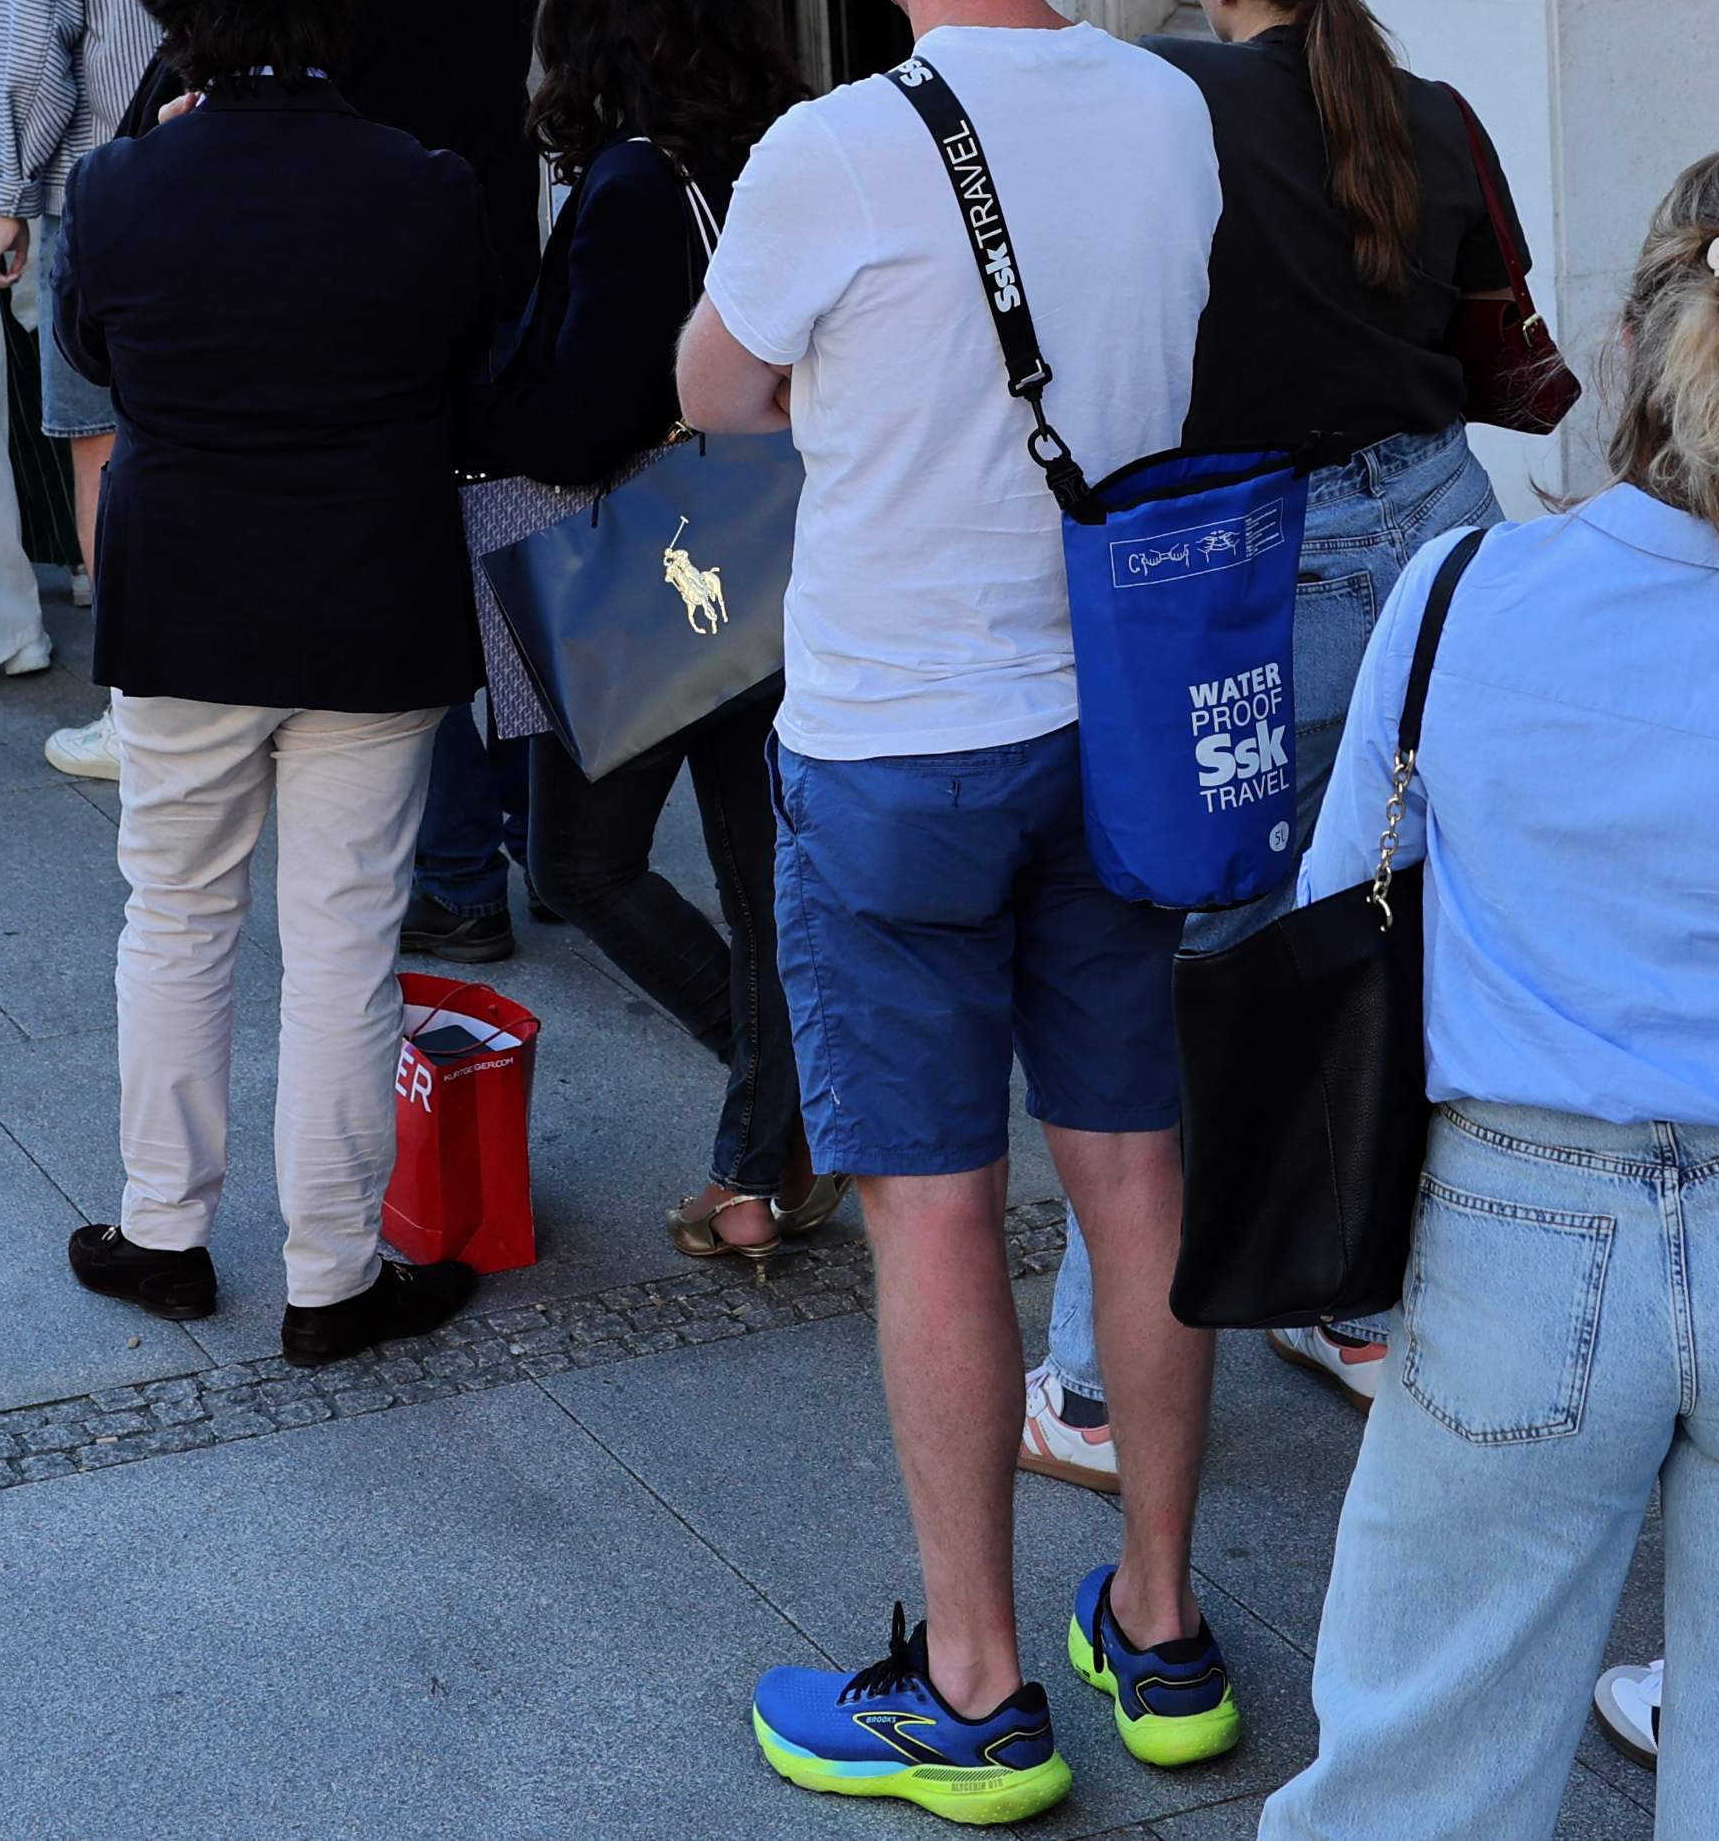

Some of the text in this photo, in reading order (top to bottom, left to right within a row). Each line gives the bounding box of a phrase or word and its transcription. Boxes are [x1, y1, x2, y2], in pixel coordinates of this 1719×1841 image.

[1188, 662, 1282, 709] WATER
[1191, 687, 1283, 736] PROOF
[1195, 719, 1289, 787] Ssk
[1199, 768, 1290, 813] TRAVEL
[865, 1716, 897, 1724] BROOKS
